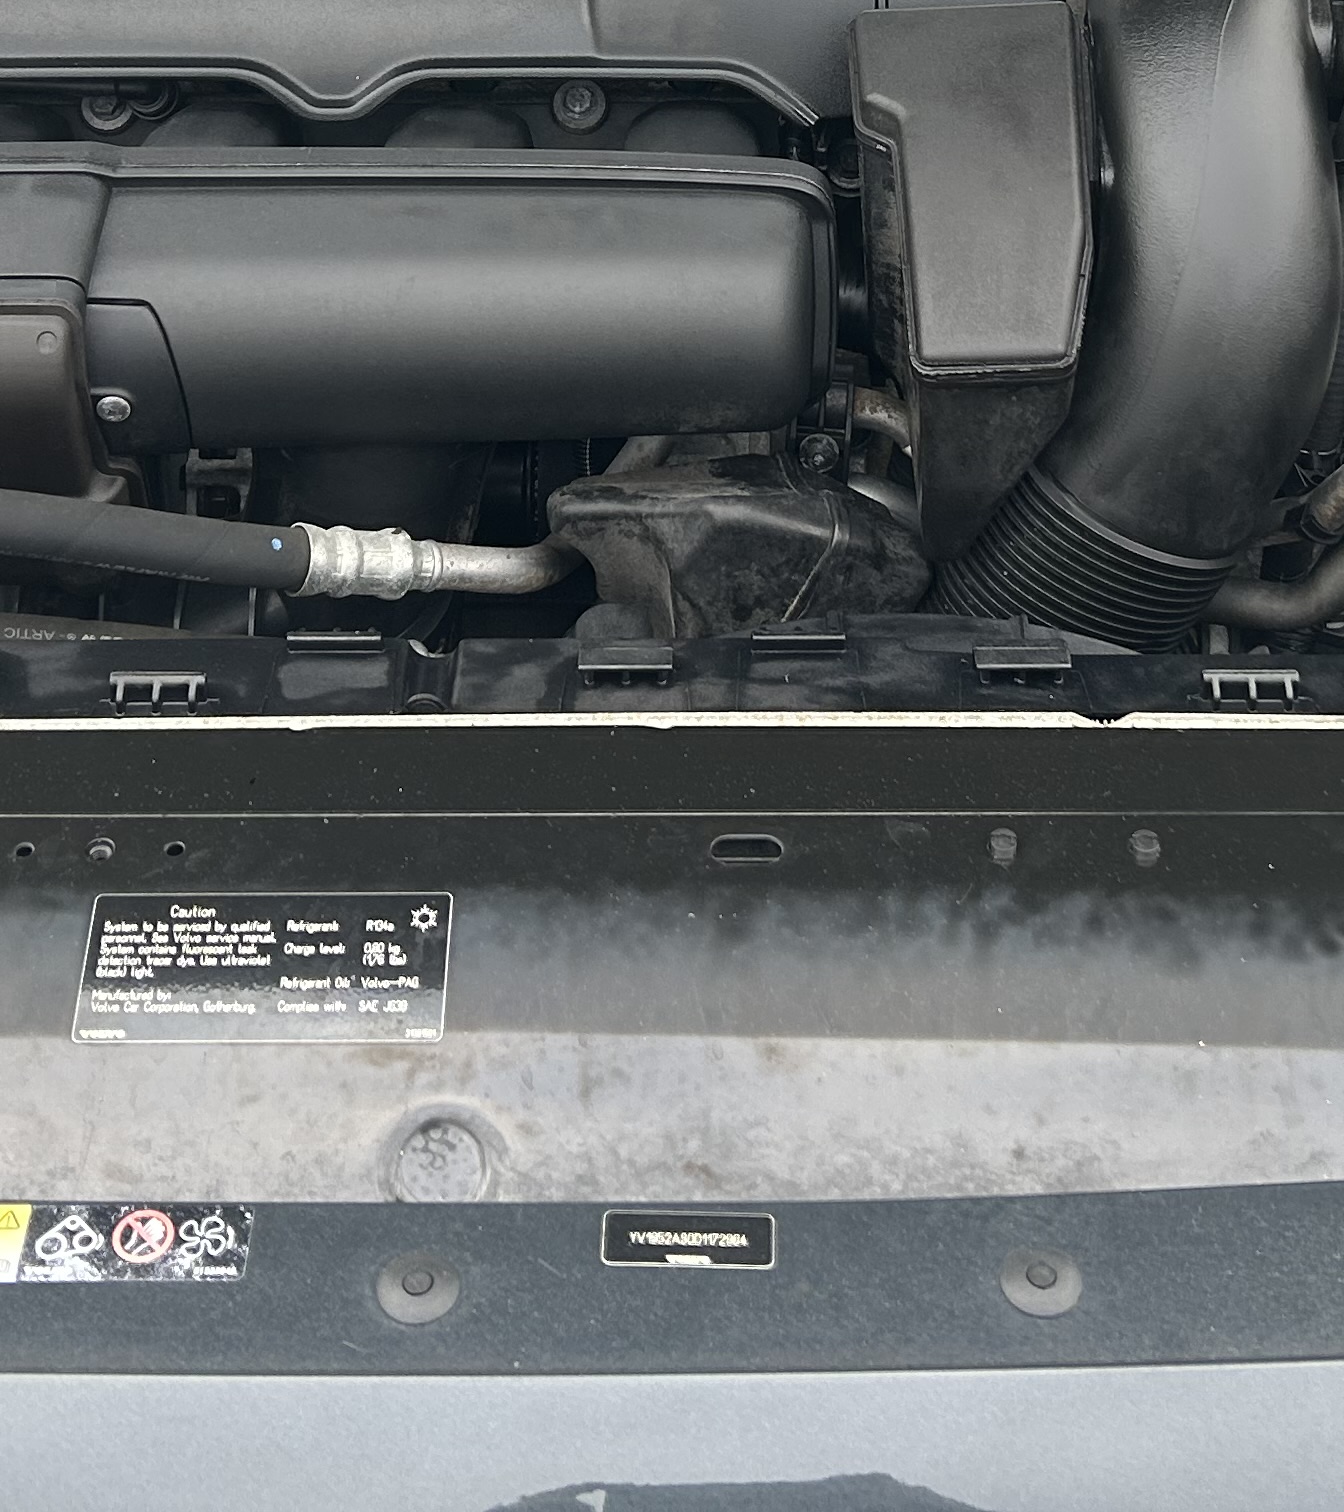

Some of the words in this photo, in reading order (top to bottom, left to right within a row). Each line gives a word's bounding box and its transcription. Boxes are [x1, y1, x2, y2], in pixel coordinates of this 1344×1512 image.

[4, 627, 55, 640] ARTIC
[169, 904, 217, 919] Caution
[103, 920, 139, 934] System
[142, 920, 154, 932] to
[156, 920, 169, 932] be
[213, 920, 227, 934] by
[230, 920, 272, 934] qualified
[151, 932, 169, 944] See
[173, 932, 202, 944] Volvo
[99, 944, 135, 957] System
[137, 944, 178, 956] contains
[181, 943, 234, 955] fluorescent
[283, 941, 316, 957] Charge
[97, 955, 142, 967] detection
[199, 955, 218, 966] Use
[220, 954, 272, 967] ultraviolet
[279, 976, 332, 991] Refrigerant
[91, 989, 154, 1001] Manufactured
[91, 1001, 121, 1013] Volvo
[123, 1001, 140, 1013] Car
[358, 999, 379, 1013] SAE
